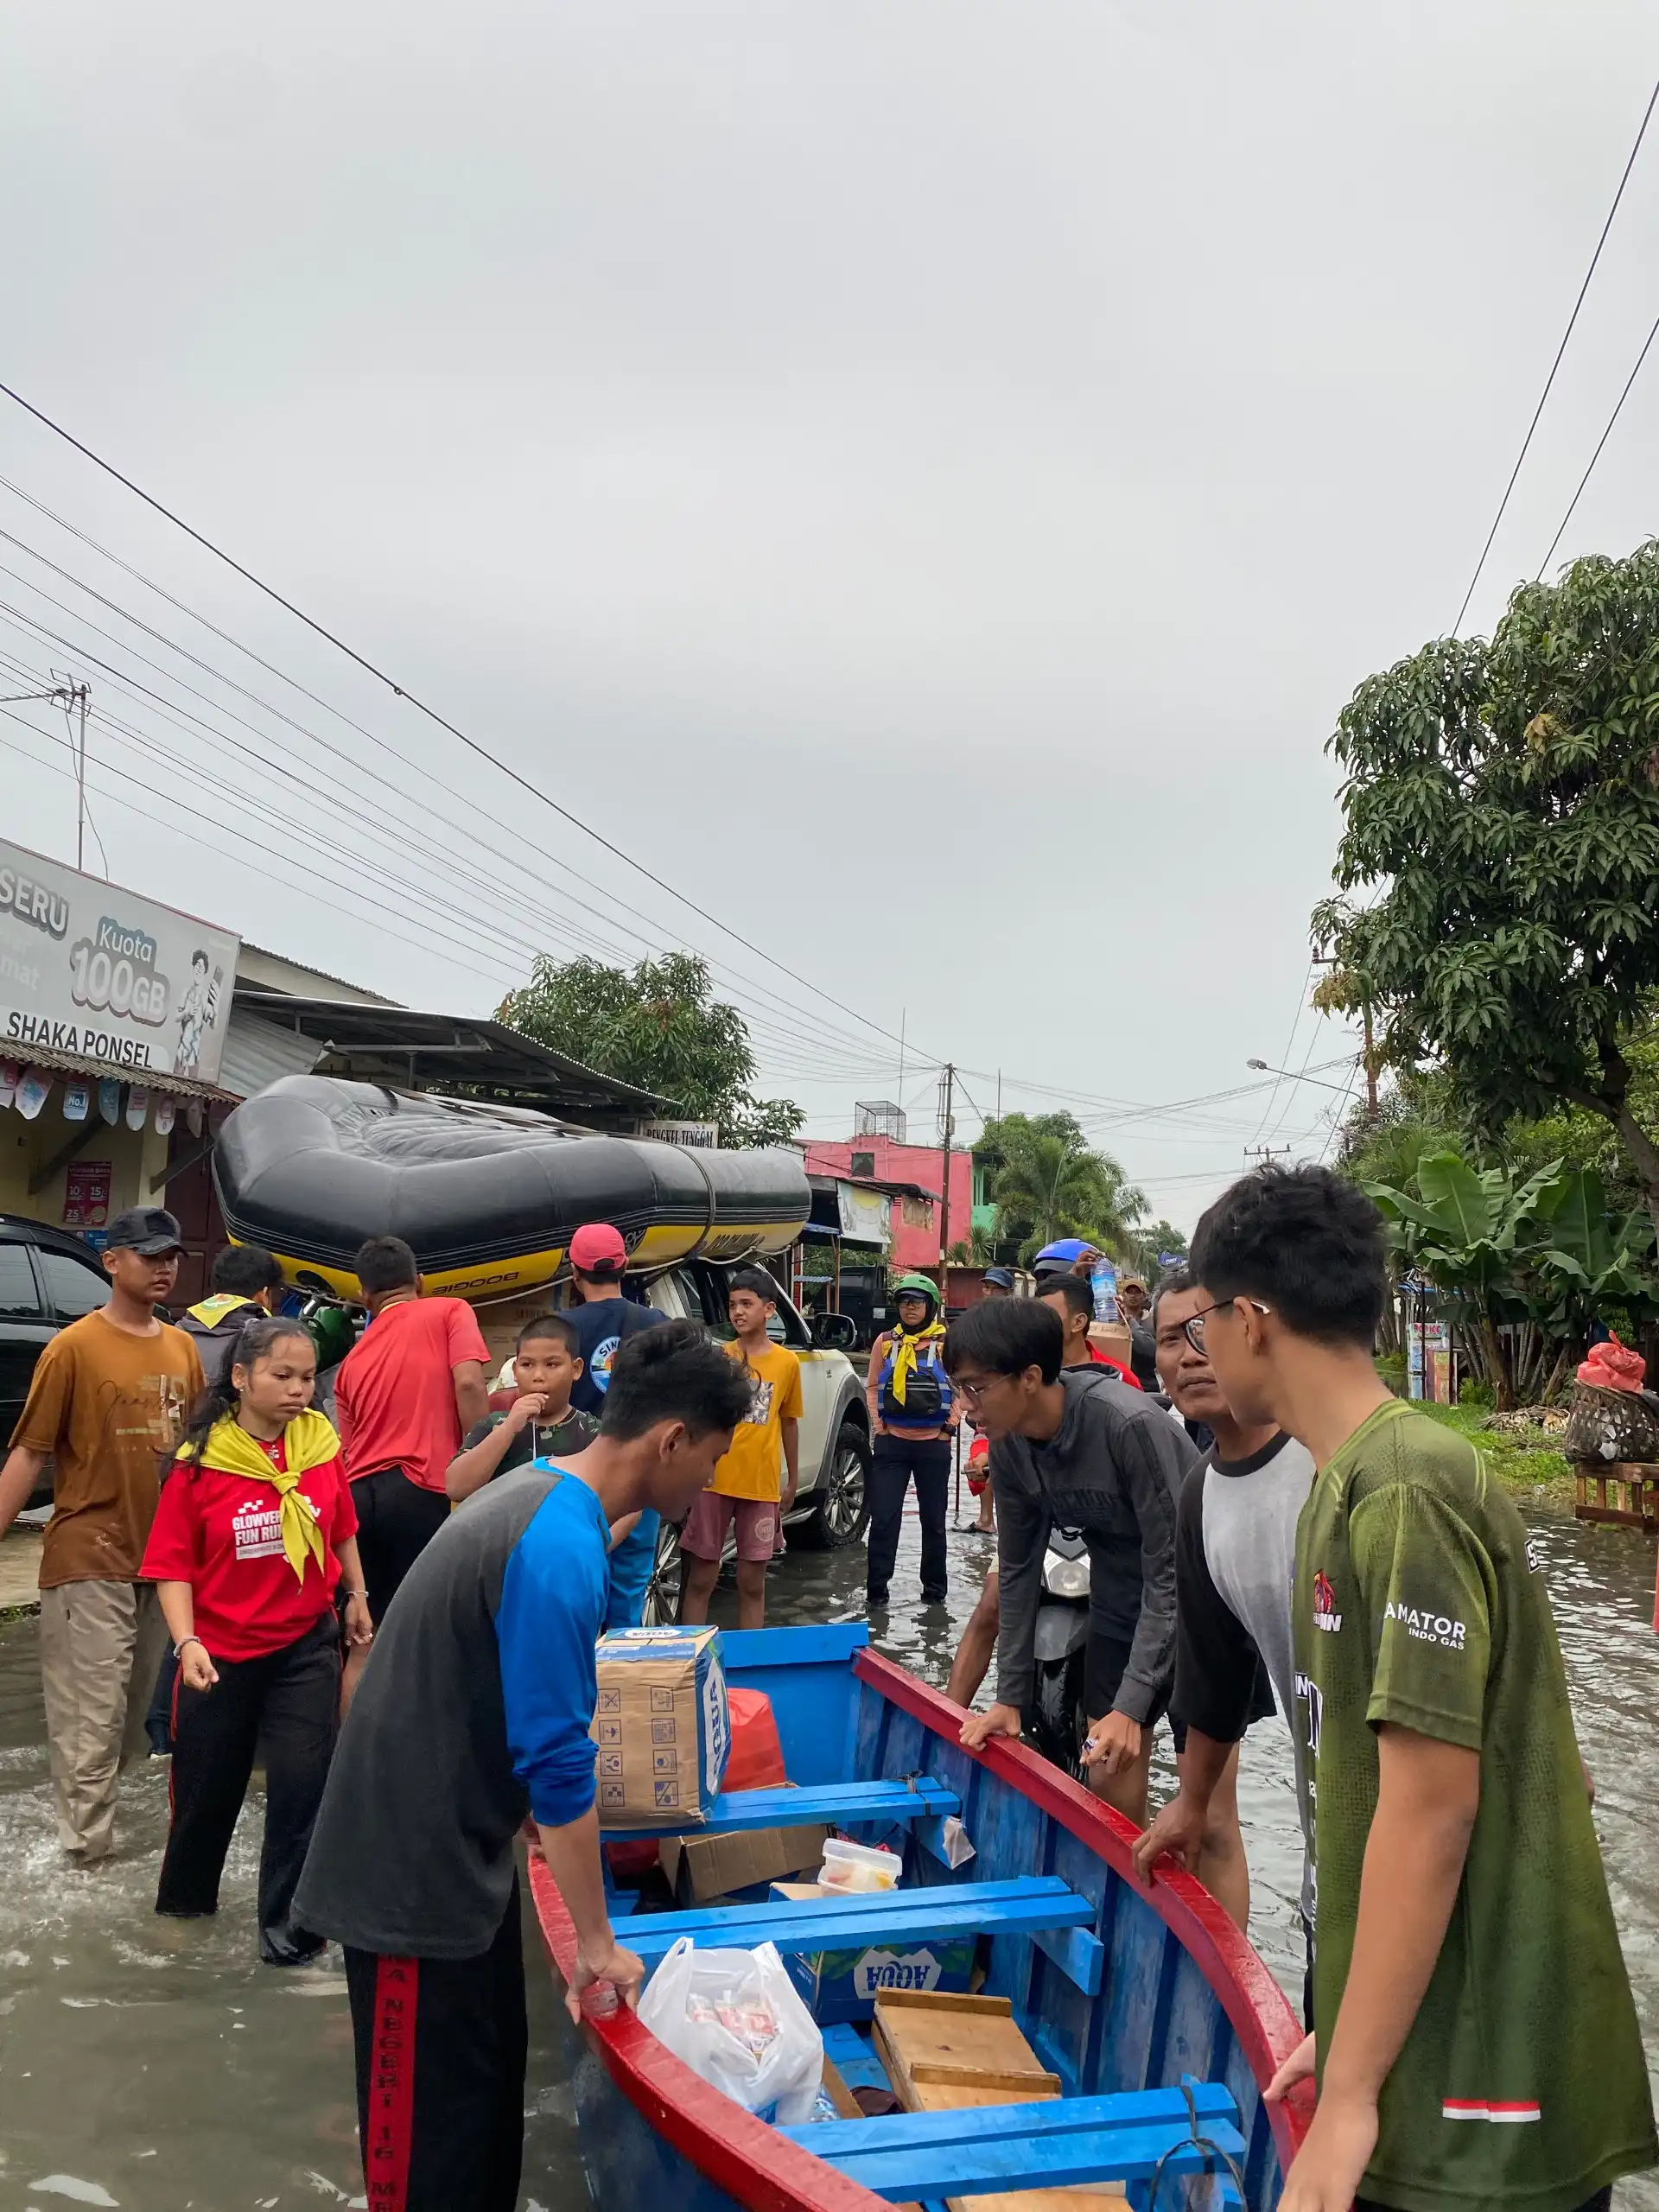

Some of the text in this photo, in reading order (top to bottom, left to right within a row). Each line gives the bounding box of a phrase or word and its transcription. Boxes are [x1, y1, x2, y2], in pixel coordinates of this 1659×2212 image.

[0, 869, 67, 931] SERU
[100, 924, 152, 963] Kuota
[73, 947, 167, 1015] 100GB
[7, 1012, 152, 1068] SHAKA PONSEL
[432, 1272, 520, 1295] BOOGIE
[235, 1528, 259, 1547] FUN
[1383, 1601, 1466, 1641] AMATOR
[1408, 1627, 1465, 1650] INDO GAS
